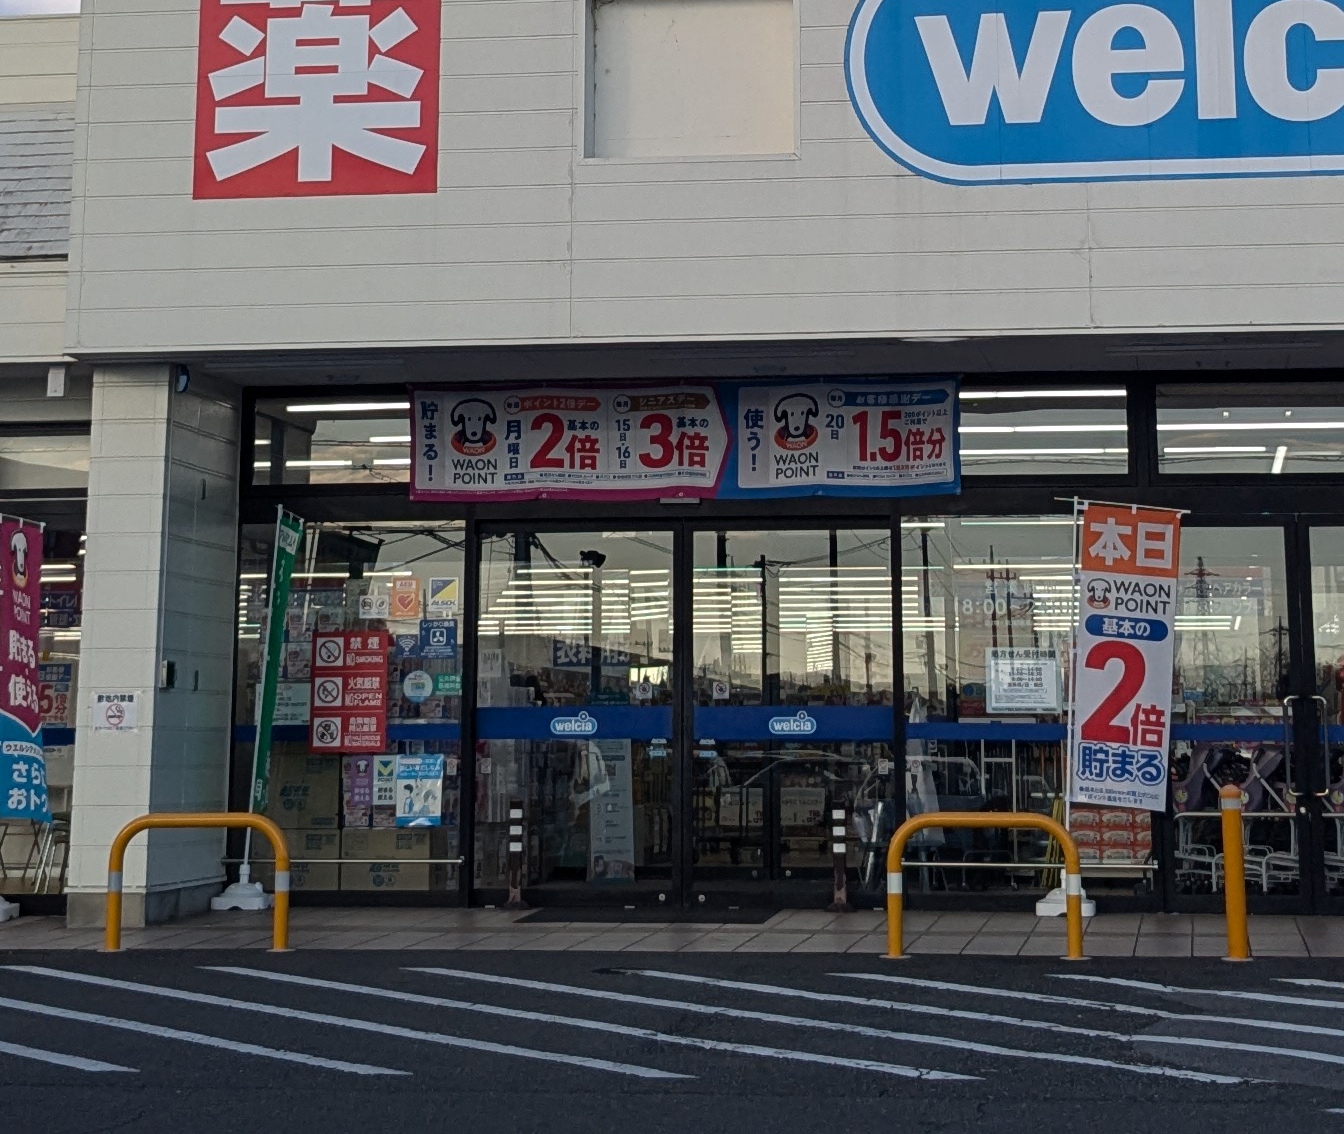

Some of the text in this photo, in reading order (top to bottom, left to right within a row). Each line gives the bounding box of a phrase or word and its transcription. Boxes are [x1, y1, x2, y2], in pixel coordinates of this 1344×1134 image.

[567, 419, 600, 432] 基本の
[676, 416, 709, 429] 基本の
[505, 419, 522, 469] 月曜日
[529, 412, 601, 471] 2倍
[638, 413, 711, 470] 3倍
[451, 458, 498, 471] WAON
[774, 452, 820, 466] WAON
[452, 472, 498, 485] POINT
[775, 466, 819, 480] POINT
[1088, 517, 1175, 568] 本日
[1114, 579, 1171, 600] WAON
[1115, 597, 1171, 615] POINT
[1102, 617, 1150, 637] 基本の
[354, 692, 383, 700] OPEN
[1080, 640, 1167, 748] 2倍
[555, 718, 593, 732] welcia
[773, 718, 811, 732] welcia
[1077, 744, 1166, 785] 貯まる
